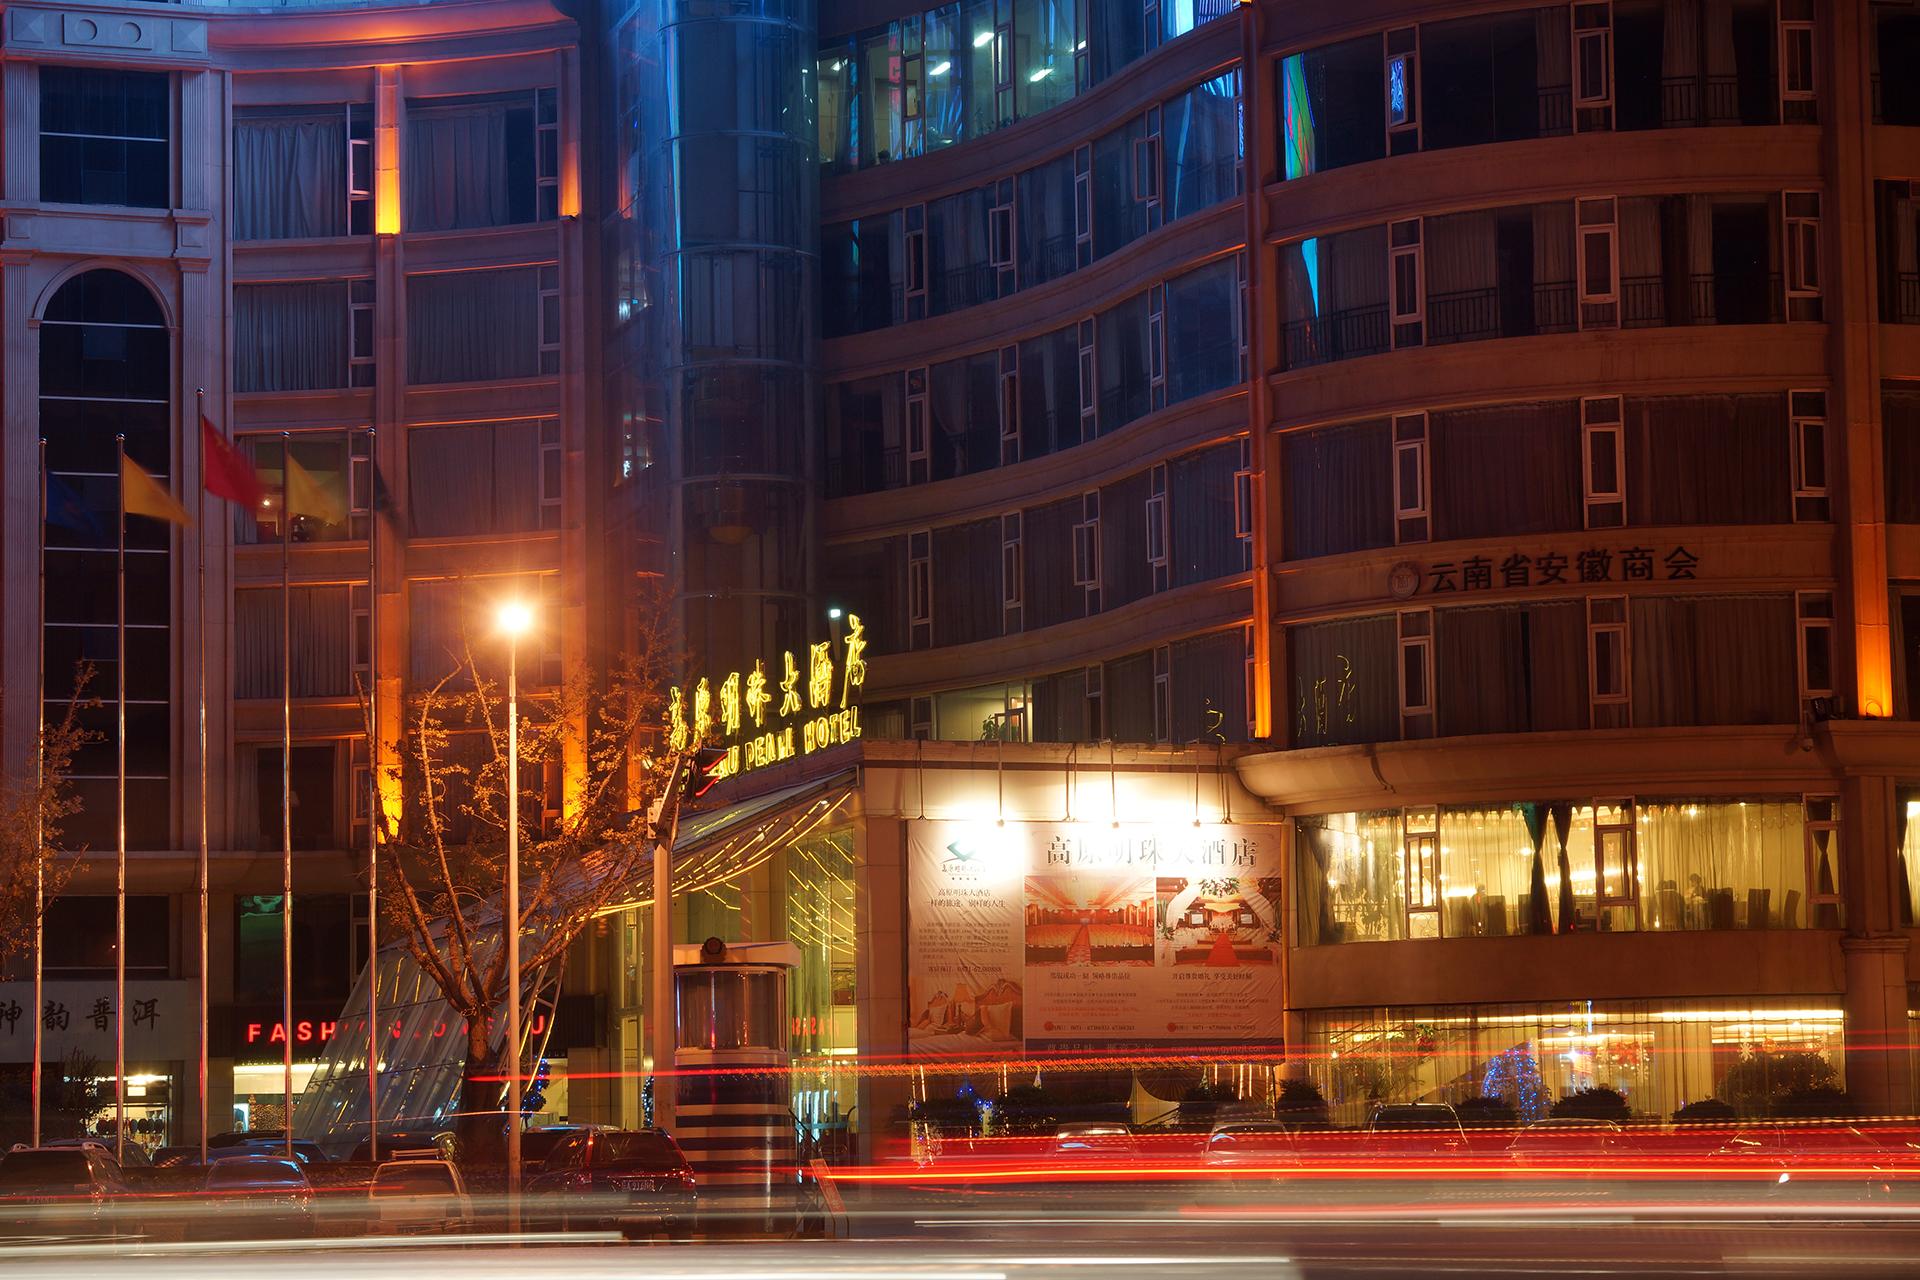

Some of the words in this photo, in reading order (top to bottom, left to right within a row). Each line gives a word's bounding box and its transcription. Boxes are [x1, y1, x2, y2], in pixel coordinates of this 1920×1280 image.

[1428, 546, 1699, 594] 云南省安徽商会
[803, 705, 862, 755] HOTEL
[0, 998, 161, 1036] 神韵普洱
